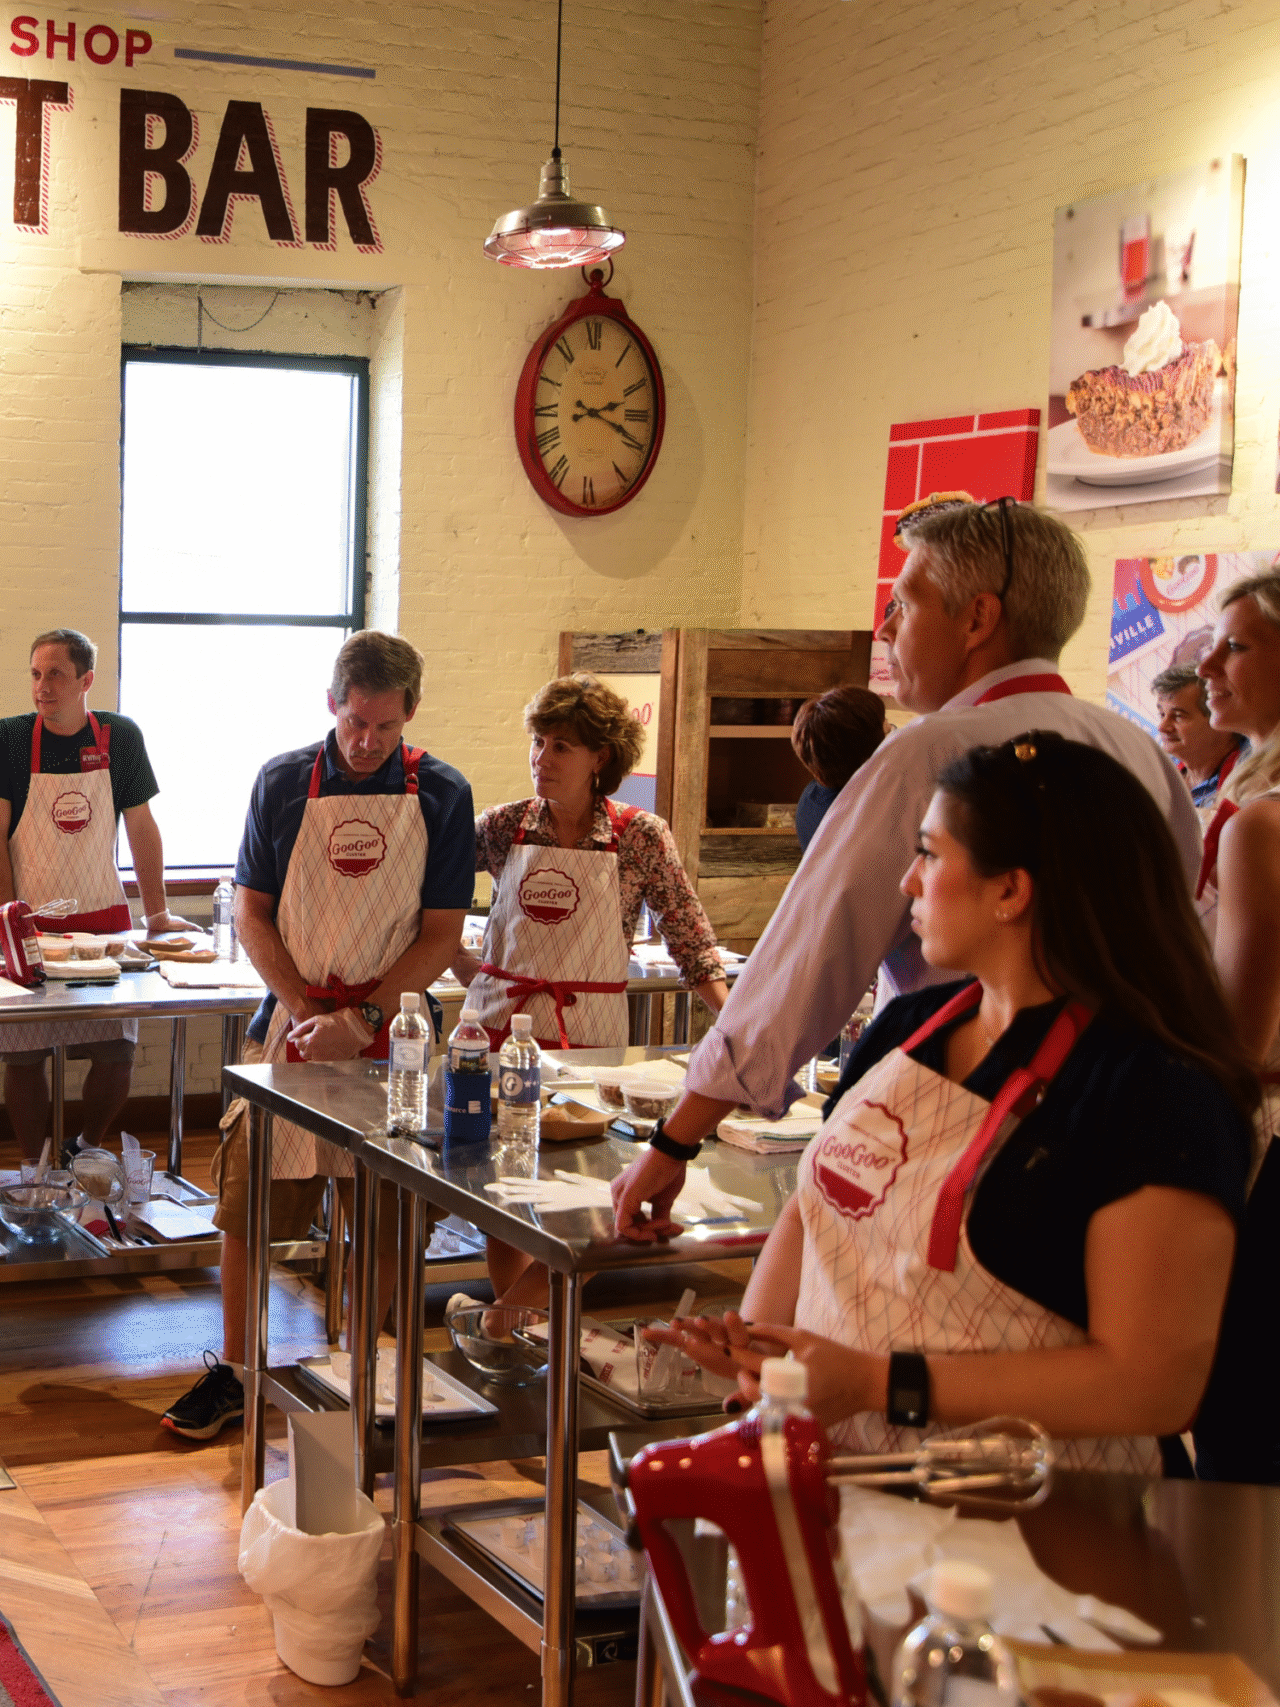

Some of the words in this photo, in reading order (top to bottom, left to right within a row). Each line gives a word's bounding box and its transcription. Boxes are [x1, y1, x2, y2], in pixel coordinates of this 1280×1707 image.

[10, 16, 153, 67] SHOP
[117, 87, 385, 254] BAR
[332, 839, 380, 855] GooGoo
[523, 888, 573, 901] GooGoo
[822, 1136, 891, 1170] GooGoo
